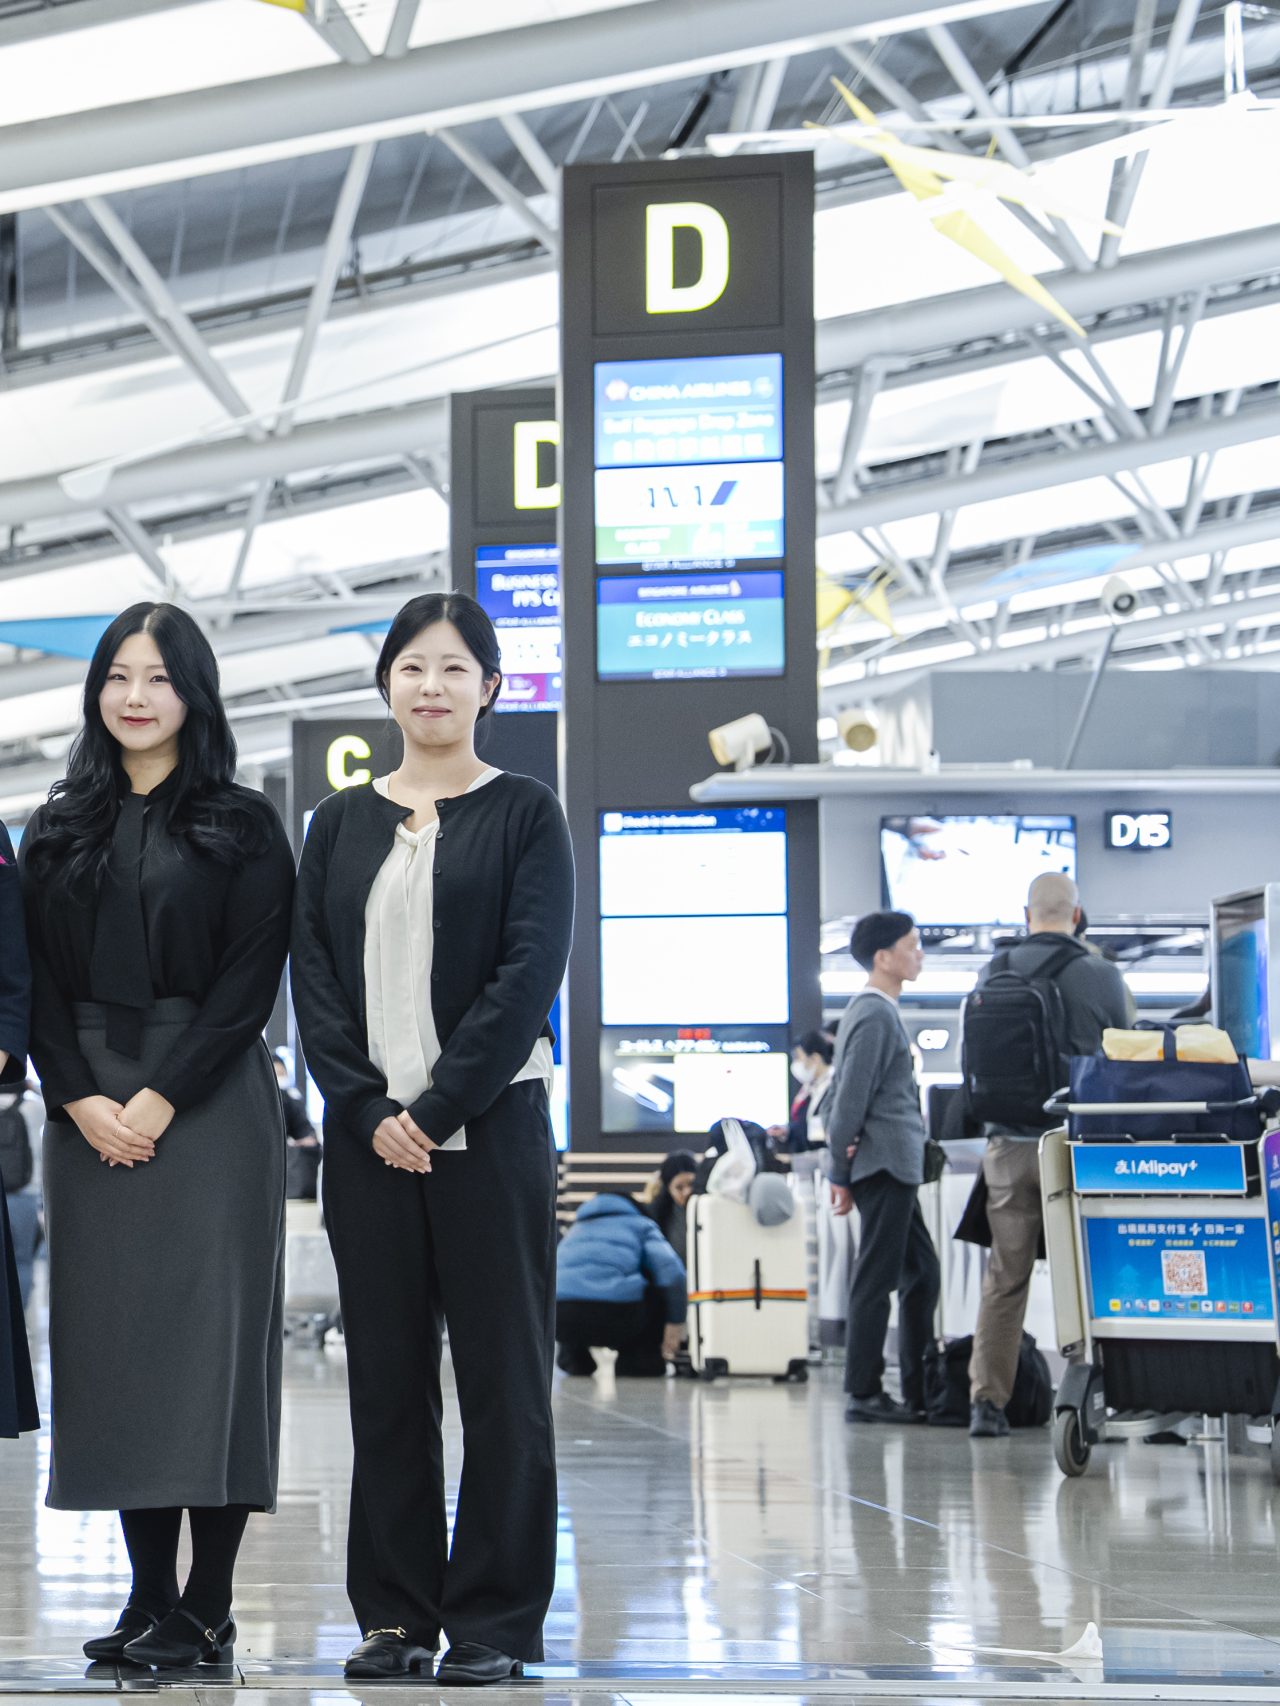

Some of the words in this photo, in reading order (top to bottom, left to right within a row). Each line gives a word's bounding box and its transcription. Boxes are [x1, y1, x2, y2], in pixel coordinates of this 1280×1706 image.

[646, 201, 730, 314] D
[629, 384, 681, 401] CHINA
[681, 380, 752, 400] AIRLINES
[627, 629, 752, 648] エコノミークラス
[327, 735, 371, 791] C
[1111, 814, 1170, 847] D15
[1137, 1159, 1198, 1177] Alipay+
